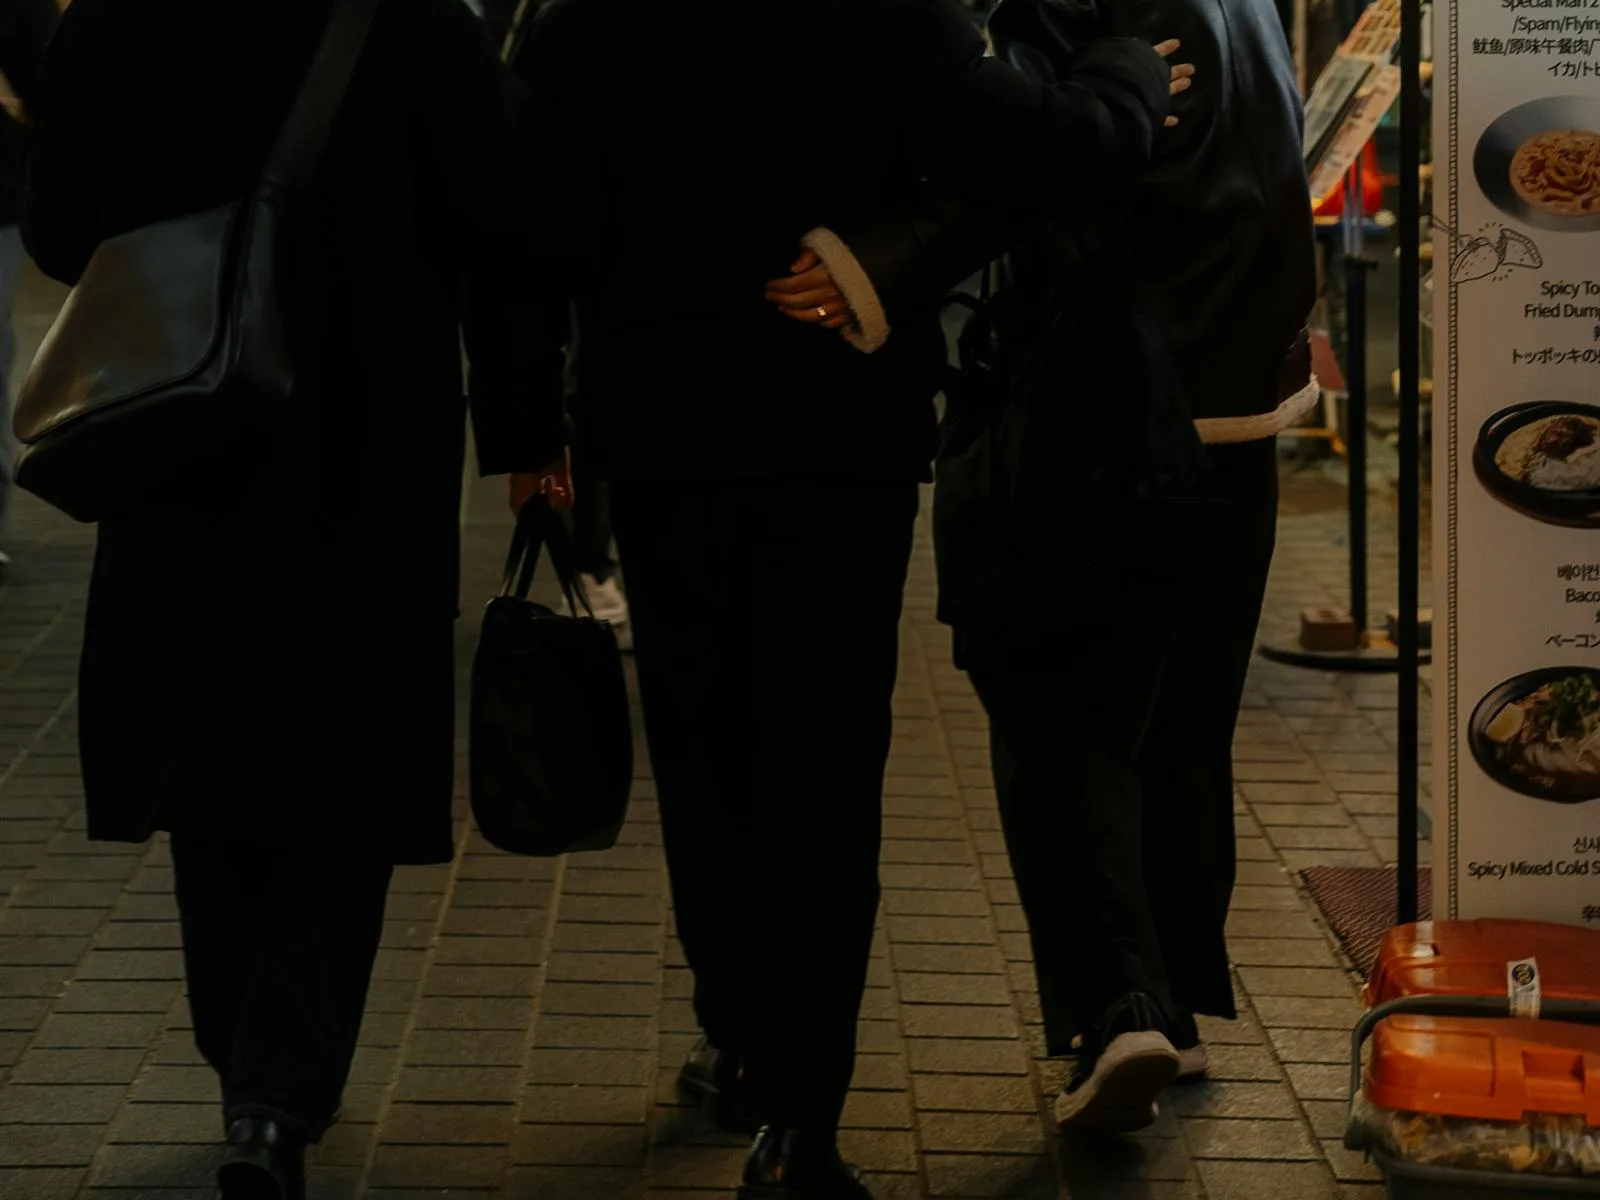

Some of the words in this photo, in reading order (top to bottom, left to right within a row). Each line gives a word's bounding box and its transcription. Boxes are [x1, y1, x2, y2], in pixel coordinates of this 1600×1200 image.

[1512, 15, 1600, 34] /Spam/Flyin
[1541, 280, 1580, 299] Spicy
[1525, 303, 1560, 318] Fried
[1513, 348, 1600, 365] トッポッキの
[1468, 861, 1508, 880] Spicy
[1510, 860, 1553, 876] Mixed
[1556, 860, 1588, 876] Cold
